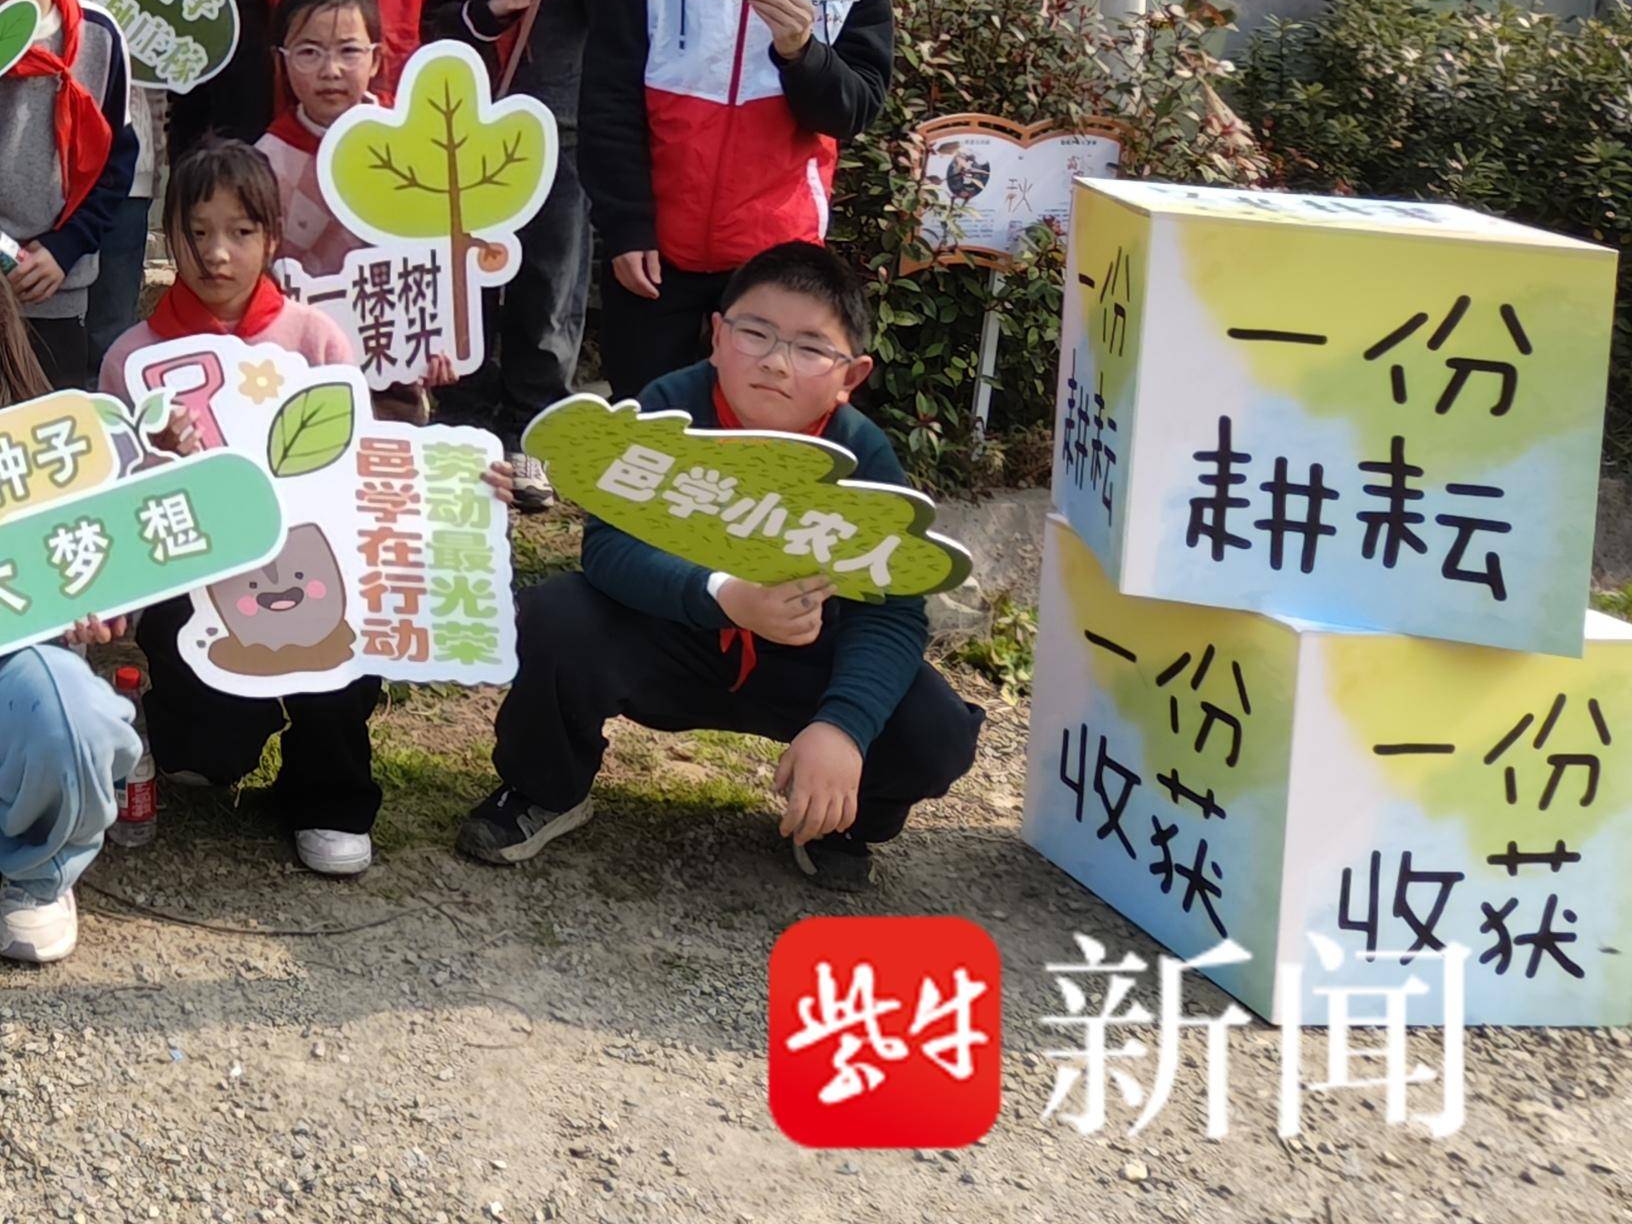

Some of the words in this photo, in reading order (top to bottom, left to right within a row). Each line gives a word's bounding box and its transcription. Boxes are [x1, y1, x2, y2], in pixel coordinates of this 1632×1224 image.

[1077, 246, 1131, 358] 一份
[1225, 293, 1534, 417] 一份
[1061, 347, 1119, 528] 耕耘
[1184, 414, 1514, 603] 耕耘
[354, 436, 431, 663] 邑学在行动
[421, 439, 503, 666] 劳动最光荣
[595, 442, 903, 588] 邑学小农人
[1083, 629, 1253, 768] 一份
[1372, 692, 1613, 812] 一份
[1058, 722, 1228, 940] 收获
[1337, 839, 1586, 979] 收获
